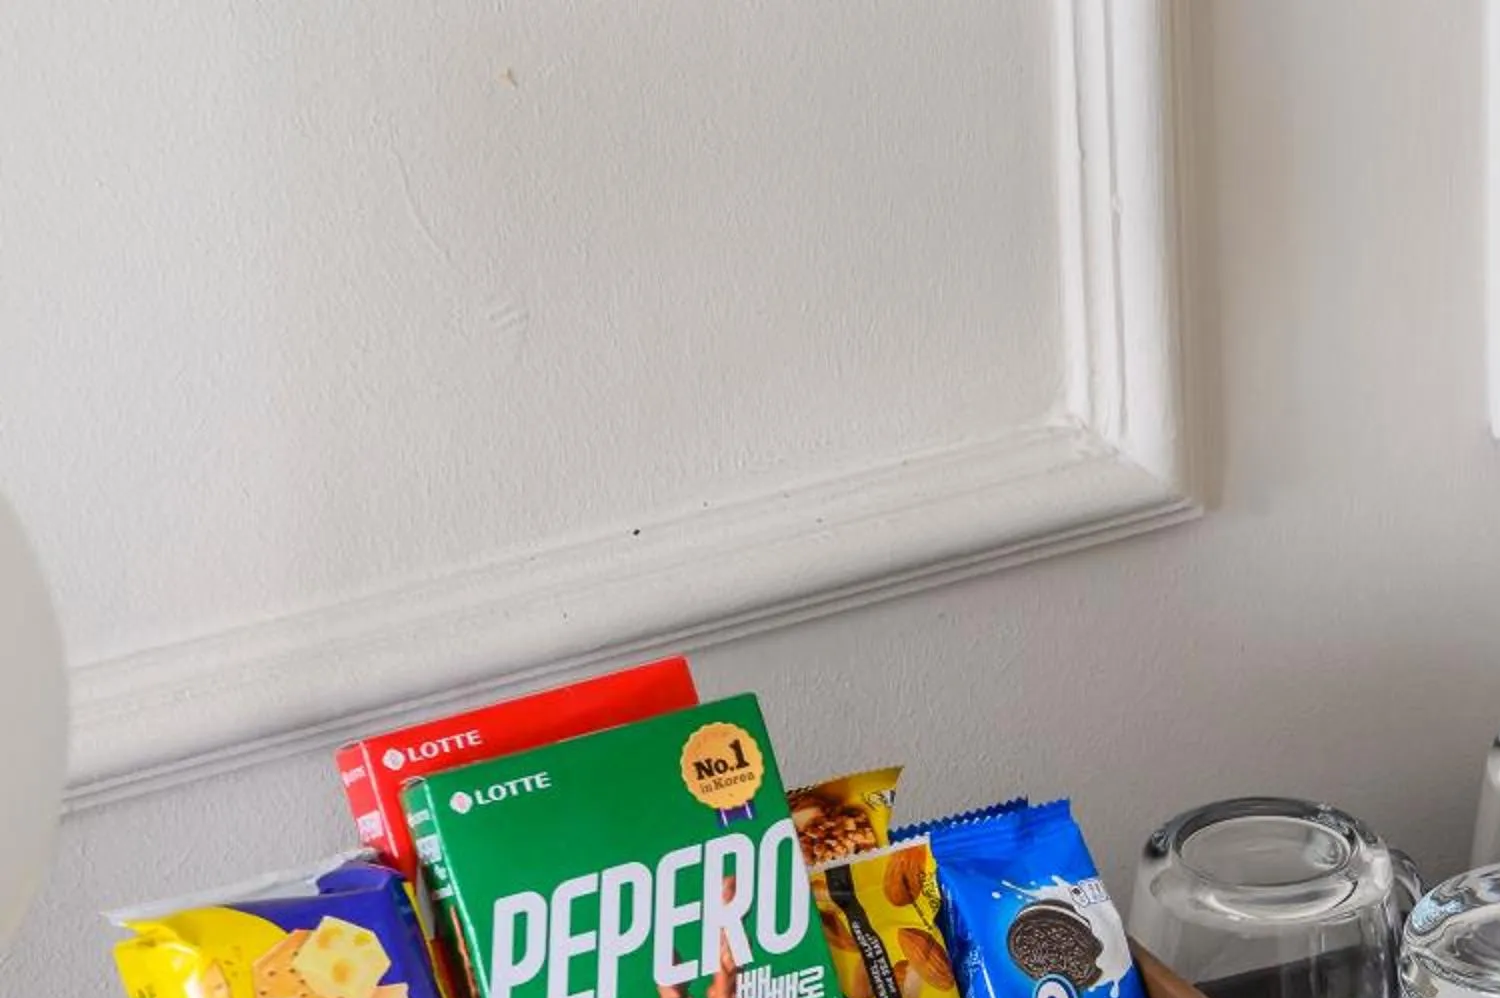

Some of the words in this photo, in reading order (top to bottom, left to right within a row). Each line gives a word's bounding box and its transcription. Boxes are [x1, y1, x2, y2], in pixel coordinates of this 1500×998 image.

[407, 729, 482, 762] LOTTE
[692, 739, 750, 780] No.1
[475, 771, 552, 805] LOTTE
[714, 772, 756, 791] Korea
